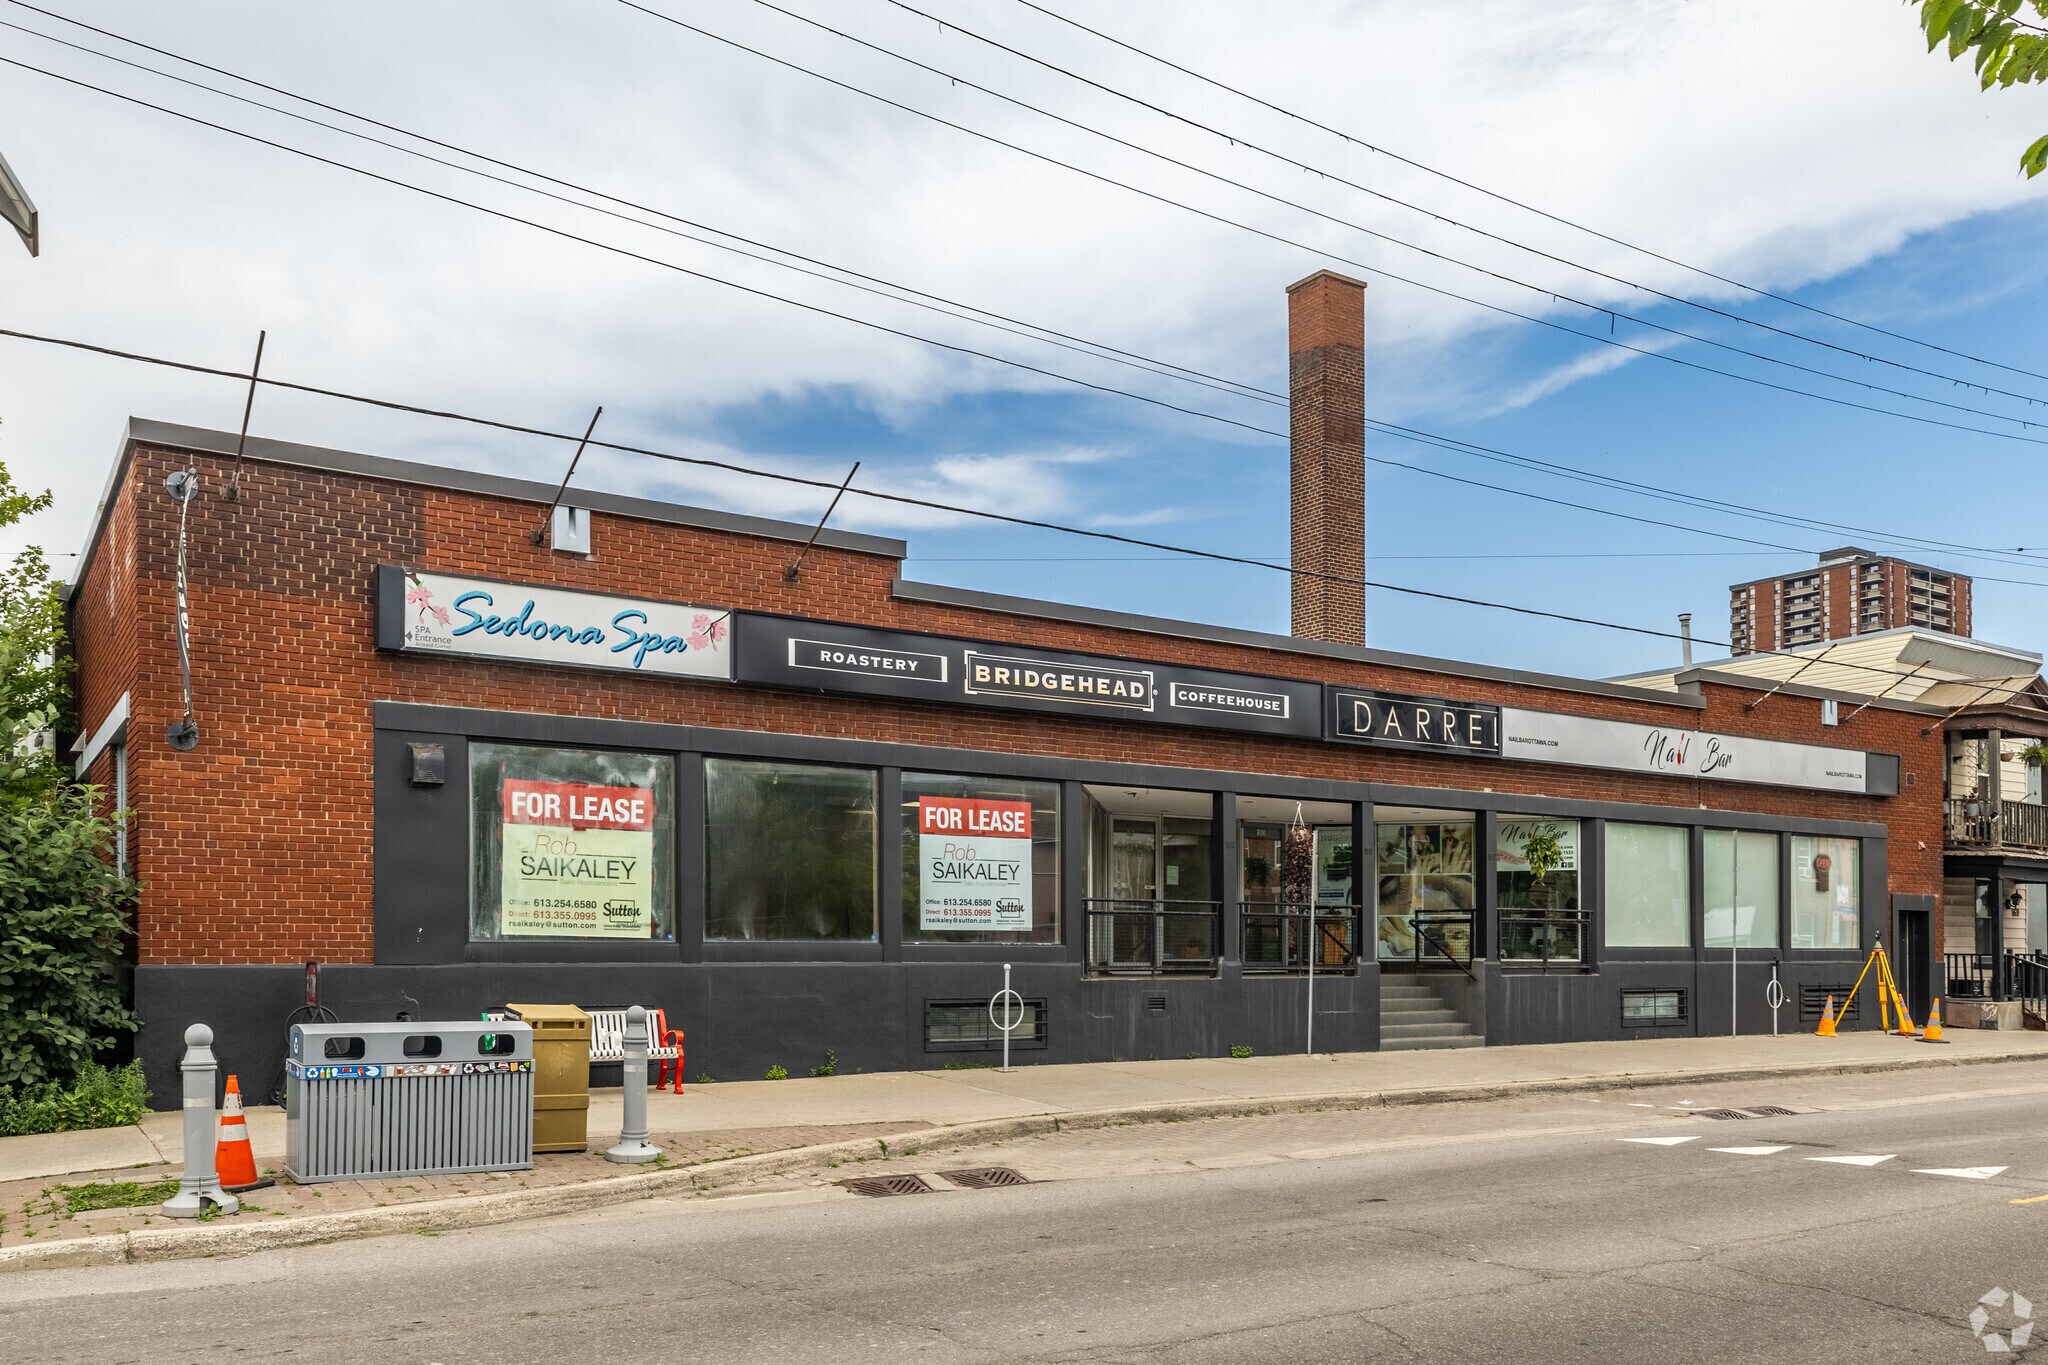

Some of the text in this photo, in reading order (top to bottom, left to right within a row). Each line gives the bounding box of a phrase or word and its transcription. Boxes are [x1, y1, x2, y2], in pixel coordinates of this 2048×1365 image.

[414, 625, 431, 634] SPA
[452, 590, 688, 668] Sedona Spa
[414, 633, 452, 644] Entrance
[820, 650, 919, 671] ROASTERY
[975, 665, 1145, 698] BRIDGEHEAD
[1178, 690, 1280, 711] COFFEEHOUSE
[1508, 736, 1559, 747] NAILBAROTTAWA.COM
[1644, 730, 1732, 773] Nail Bar
[511, 791, 645, 823] FOR LEASE
[925, 806, 1025, 833] FOR LEASE
[534, 834, 577, 855] Rob
[943, 843, 976, 861] Rob
[520, 855, 637, 879] SAIKALEY
[932, 861, 1020, 881] SAIKALEY
[533, 898, 597, 909] 613.254.6580
[602, 902, 641, 916] Sutton
[943, 898, 992, 907] 613.254.6580
[995, 900, 1025, 913] Sutton
[533, 910, 597, 921] 613.355.0995
[943, 908, 992, 917] 613.355.0995
[508, 920, 597, 929] rsaikaley@sutton.com
